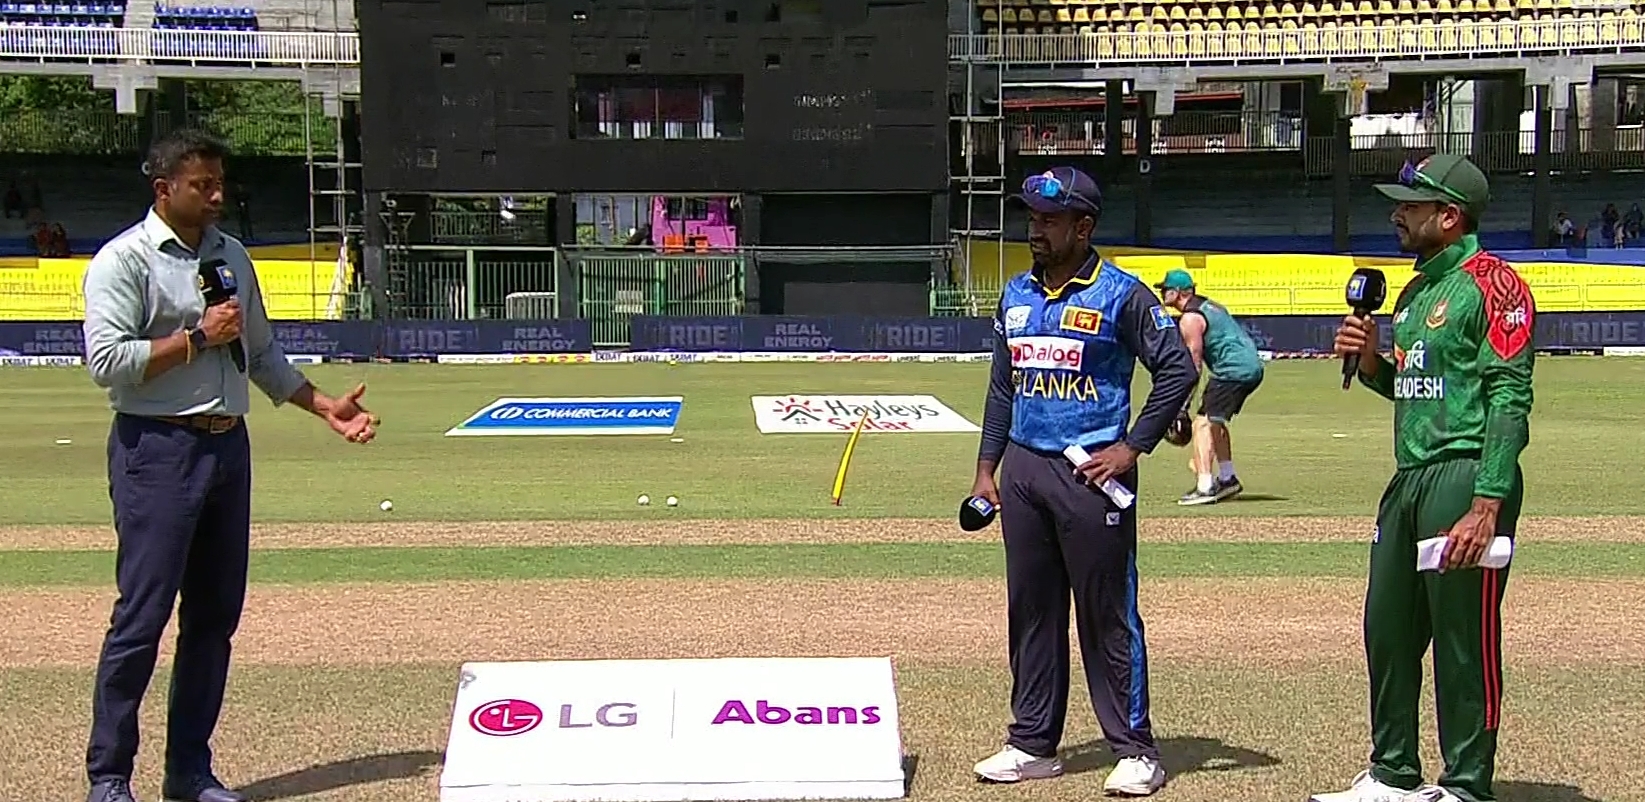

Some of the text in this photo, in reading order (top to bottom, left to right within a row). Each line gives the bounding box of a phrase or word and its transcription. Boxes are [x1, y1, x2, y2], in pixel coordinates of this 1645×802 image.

[1139, 159, 1151, 174] D
[400, 329, 461, 350] RIDE
[514, 327, 563, 339] REAL
[669, 325, 727, 346] RIDE
[775, 324, 821, 335] REAL
[886, 326, 945, 346] RIDE
[1571, 322, 1640, 342] RIDE
[502, 340, 576, 351] ENERGY
[763, 337, 833, 347] ENERGY
[1020, 343, 1081, 367] Dialog
[1022, 371, 1099, 402] LANKA
[523, 406, 673, 419] COMMERCIAL BANK
[824, 399, 940, 420] Hayleys
[827, 418, 914, 431] Solar
[558, 702, 638, 729] LG
[710, 699, 882, 725] Abans
